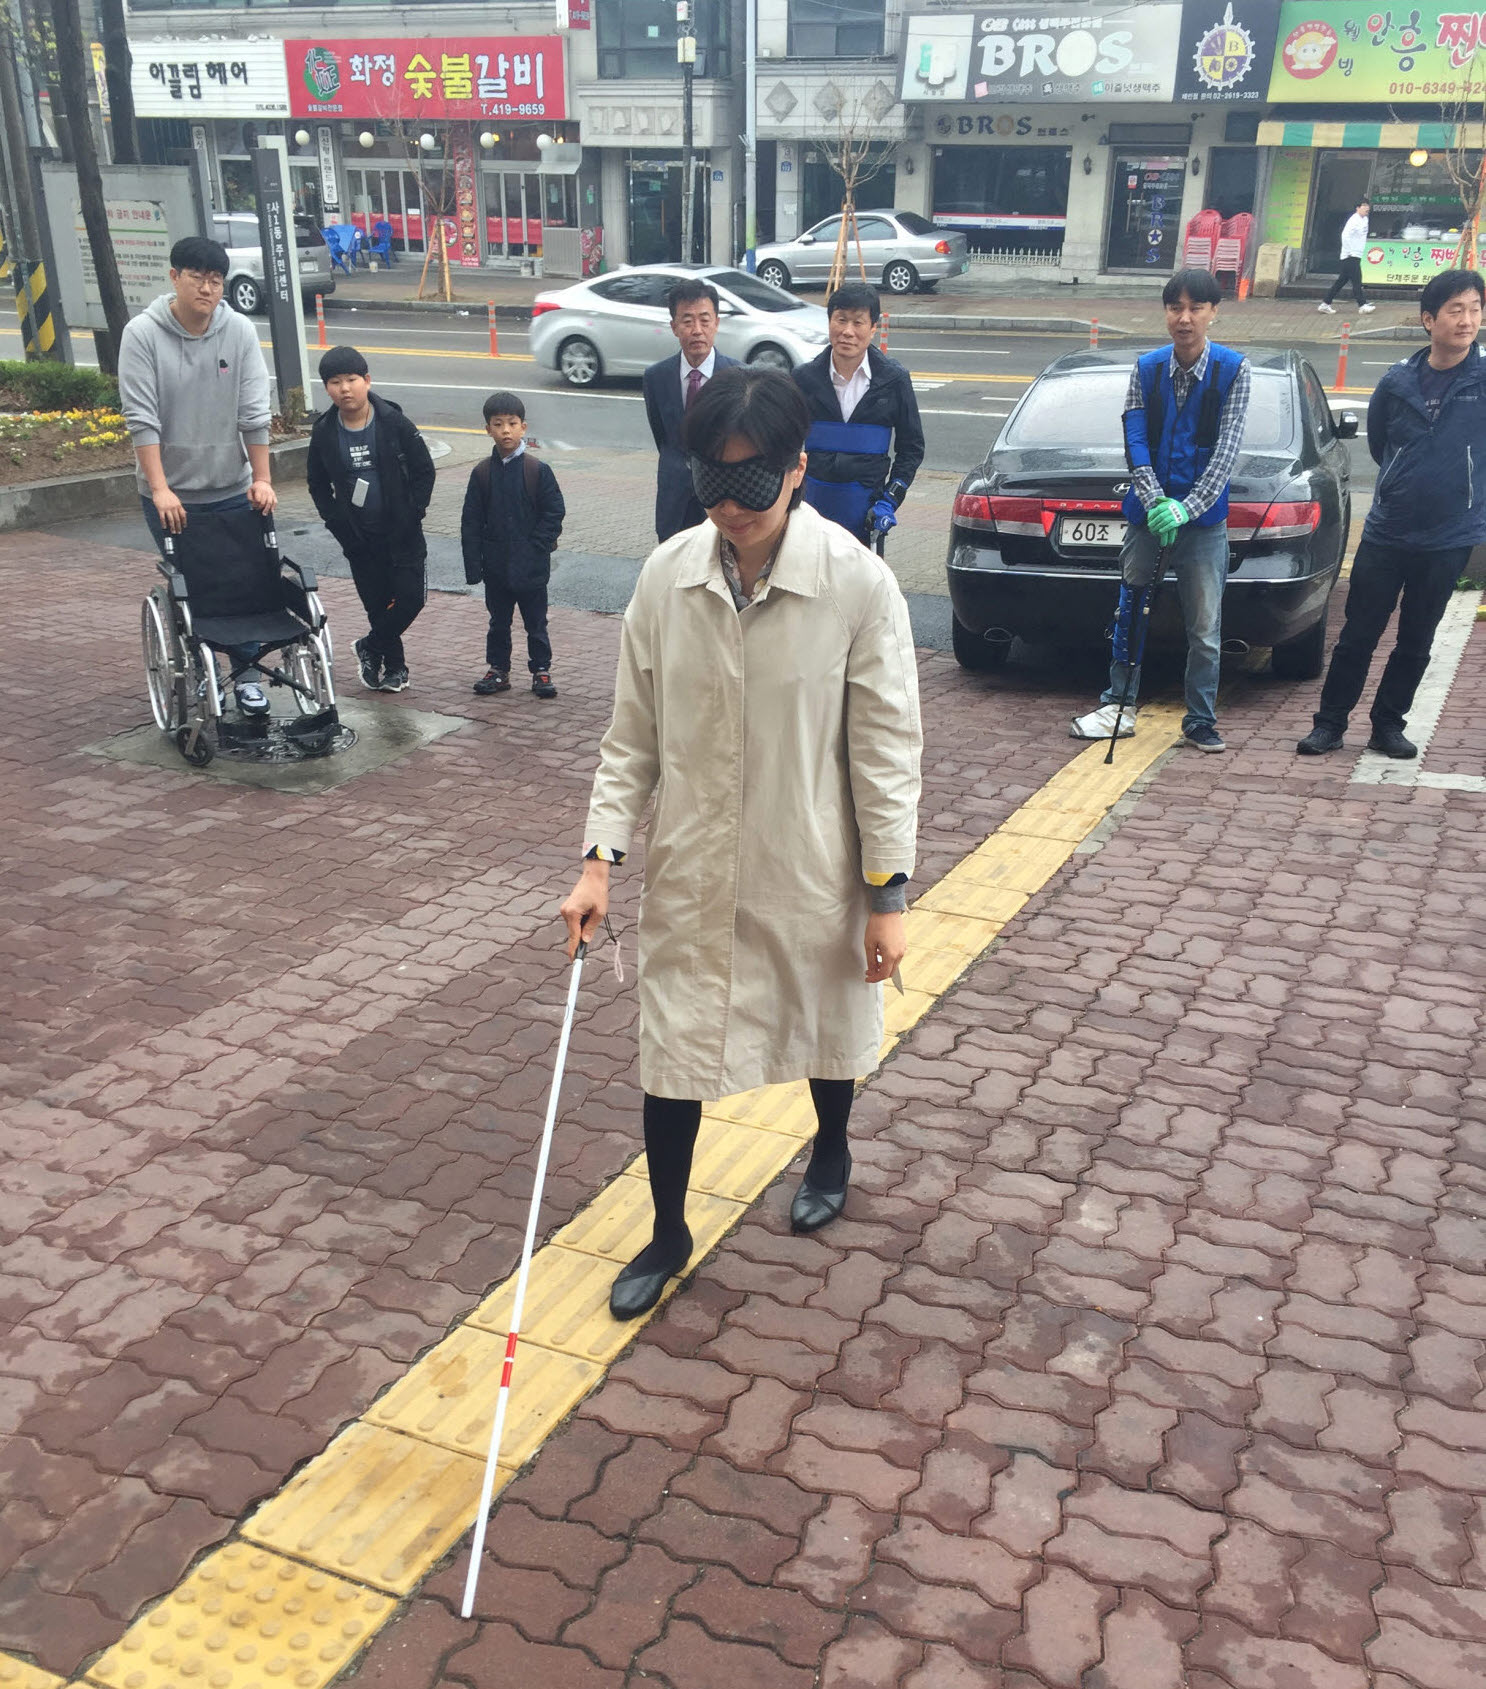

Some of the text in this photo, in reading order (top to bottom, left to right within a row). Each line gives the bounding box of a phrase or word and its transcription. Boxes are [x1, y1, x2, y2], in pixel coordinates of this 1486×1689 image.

[977, 30, 1133, 77] BROS
[1367, 9, 1427, 72] 안흥
[149, 61, 248, 99] 이끌림 헤어
[349, 54, 395, 86] 화정
[404, 53, 544, 99] 숯불갈비
[481, 103, 545, 115] T.419-9659
[957, 114, 1032, 136] BROS
[271, 200, 282, 239] 사1동
[275, 243, 289, 303] 주민센터
[1072, 522, 1110, 541] 60조
